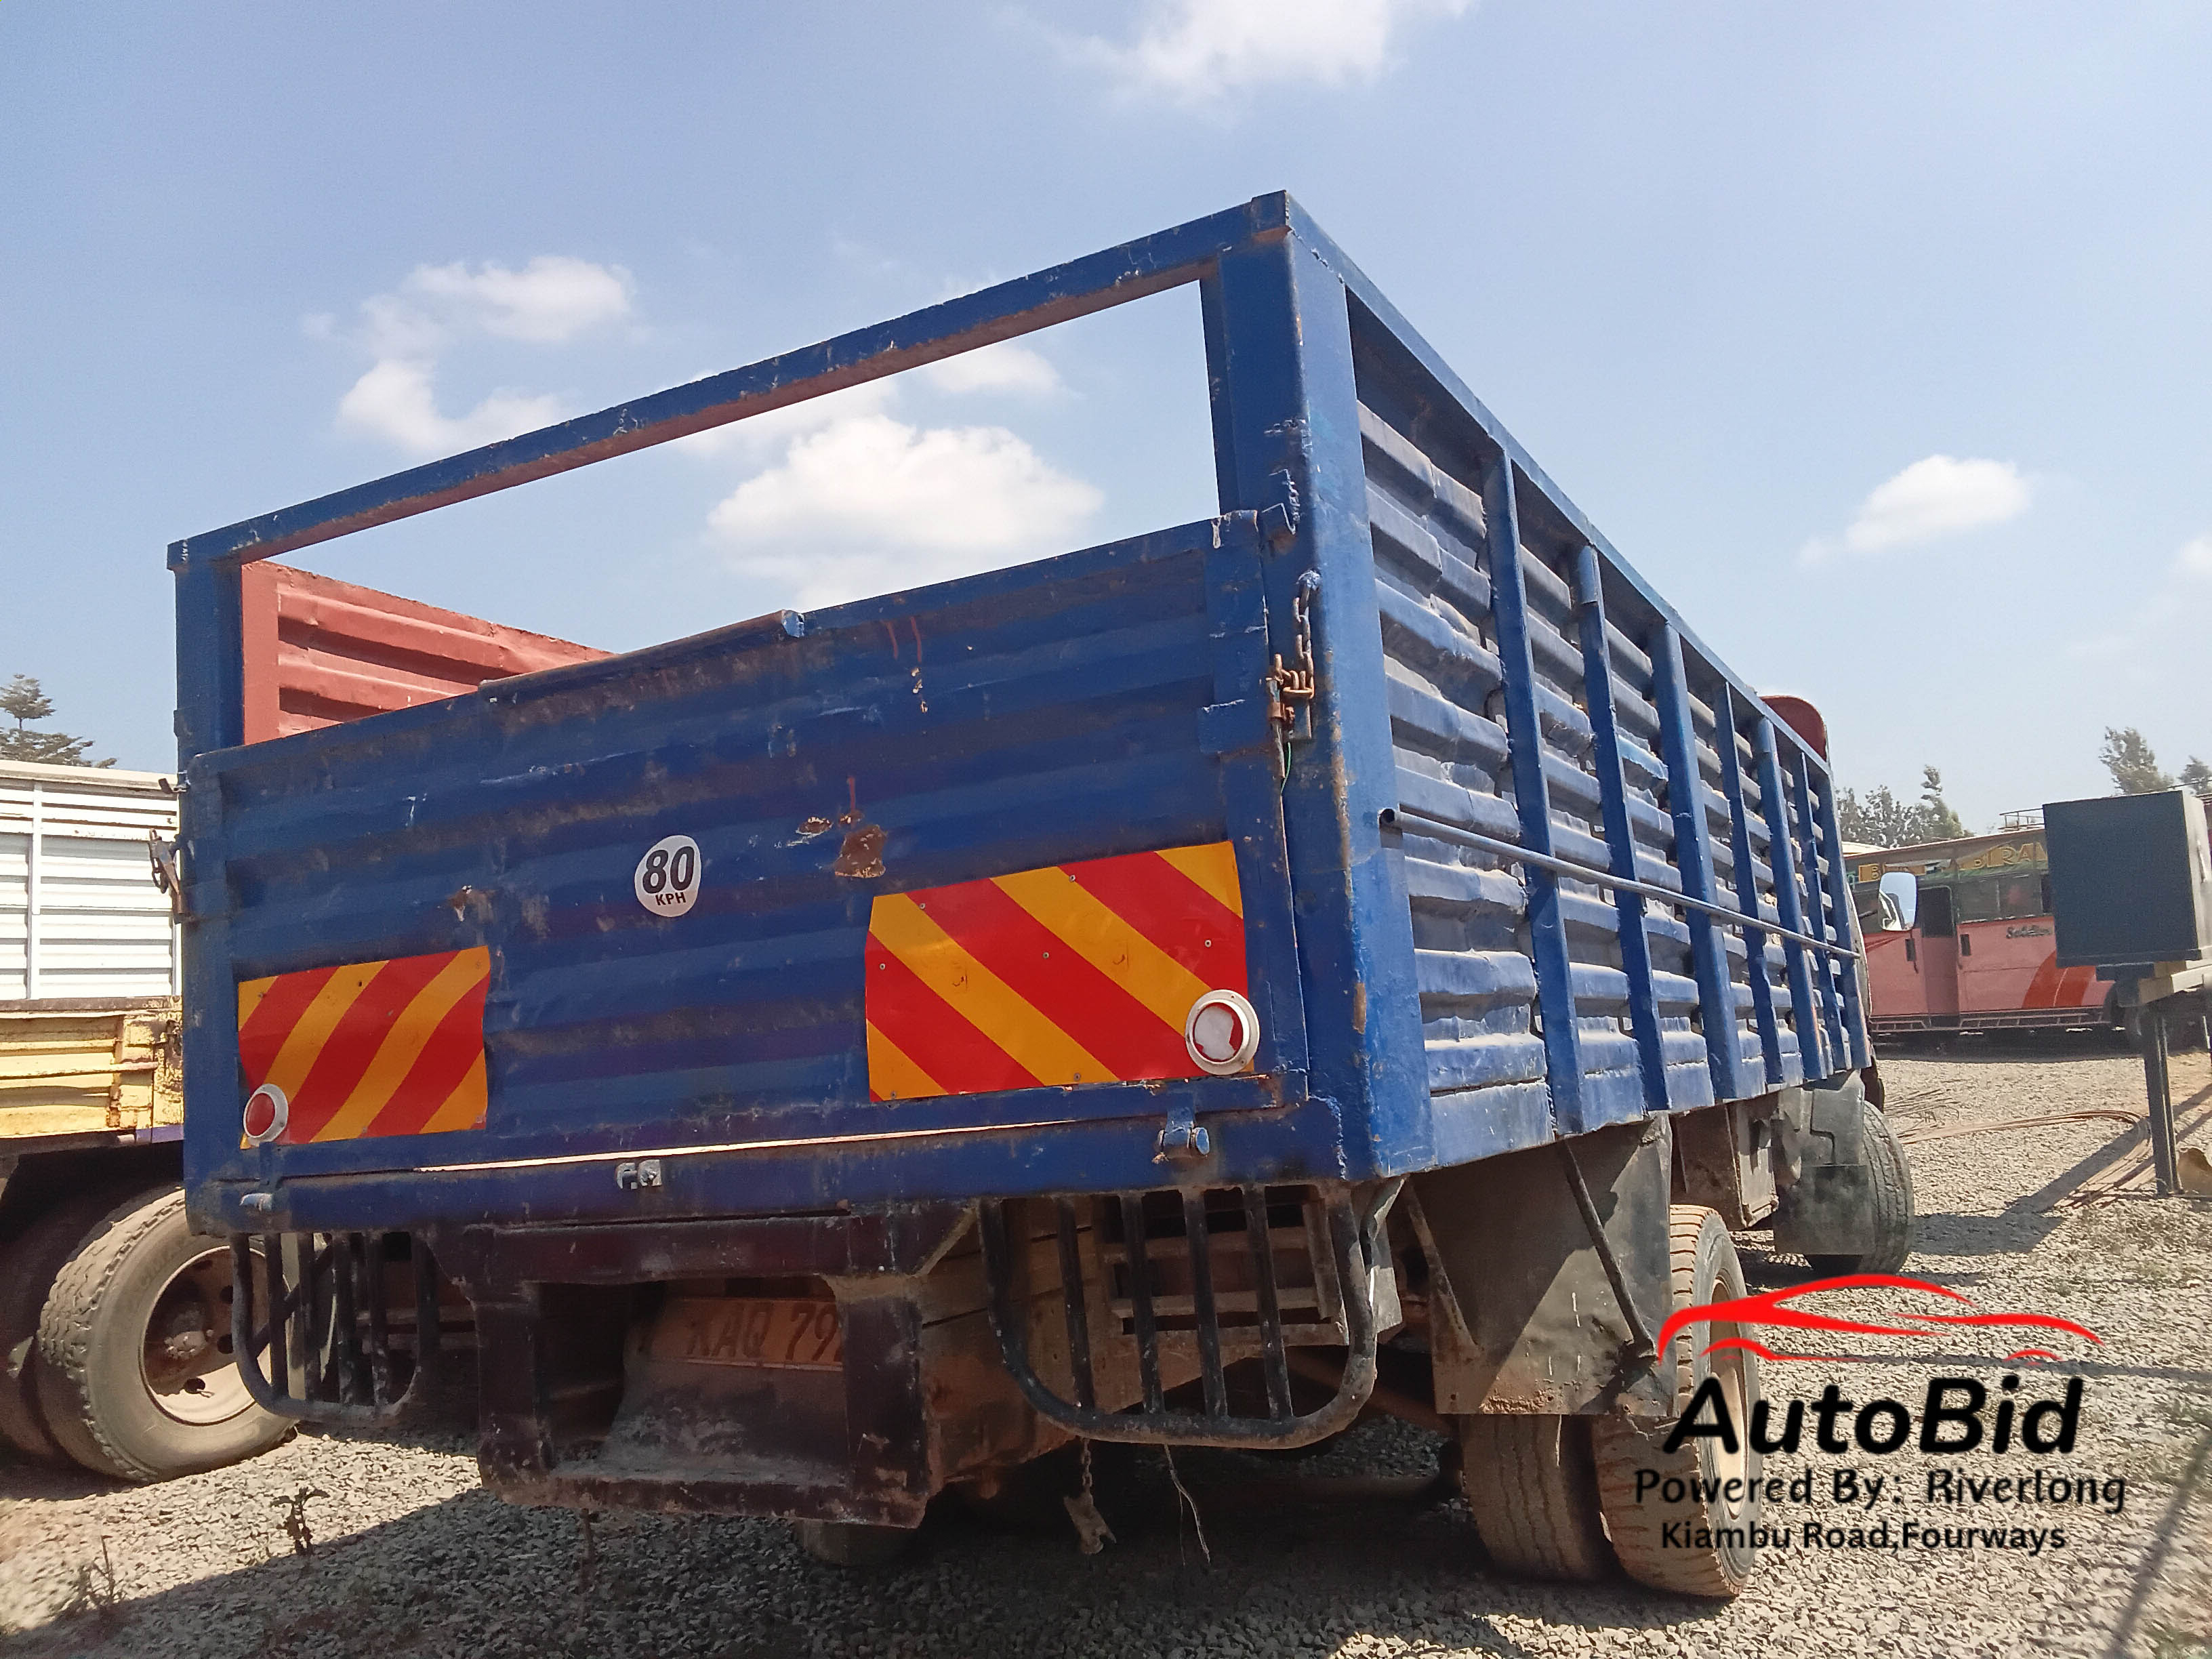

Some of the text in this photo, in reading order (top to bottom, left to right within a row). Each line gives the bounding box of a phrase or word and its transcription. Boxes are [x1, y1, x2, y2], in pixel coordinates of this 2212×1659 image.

[642, 846, 695, 894] 80
[655, 892, 687, 906] KPH
[785, 1301, 842, 1362] 79
